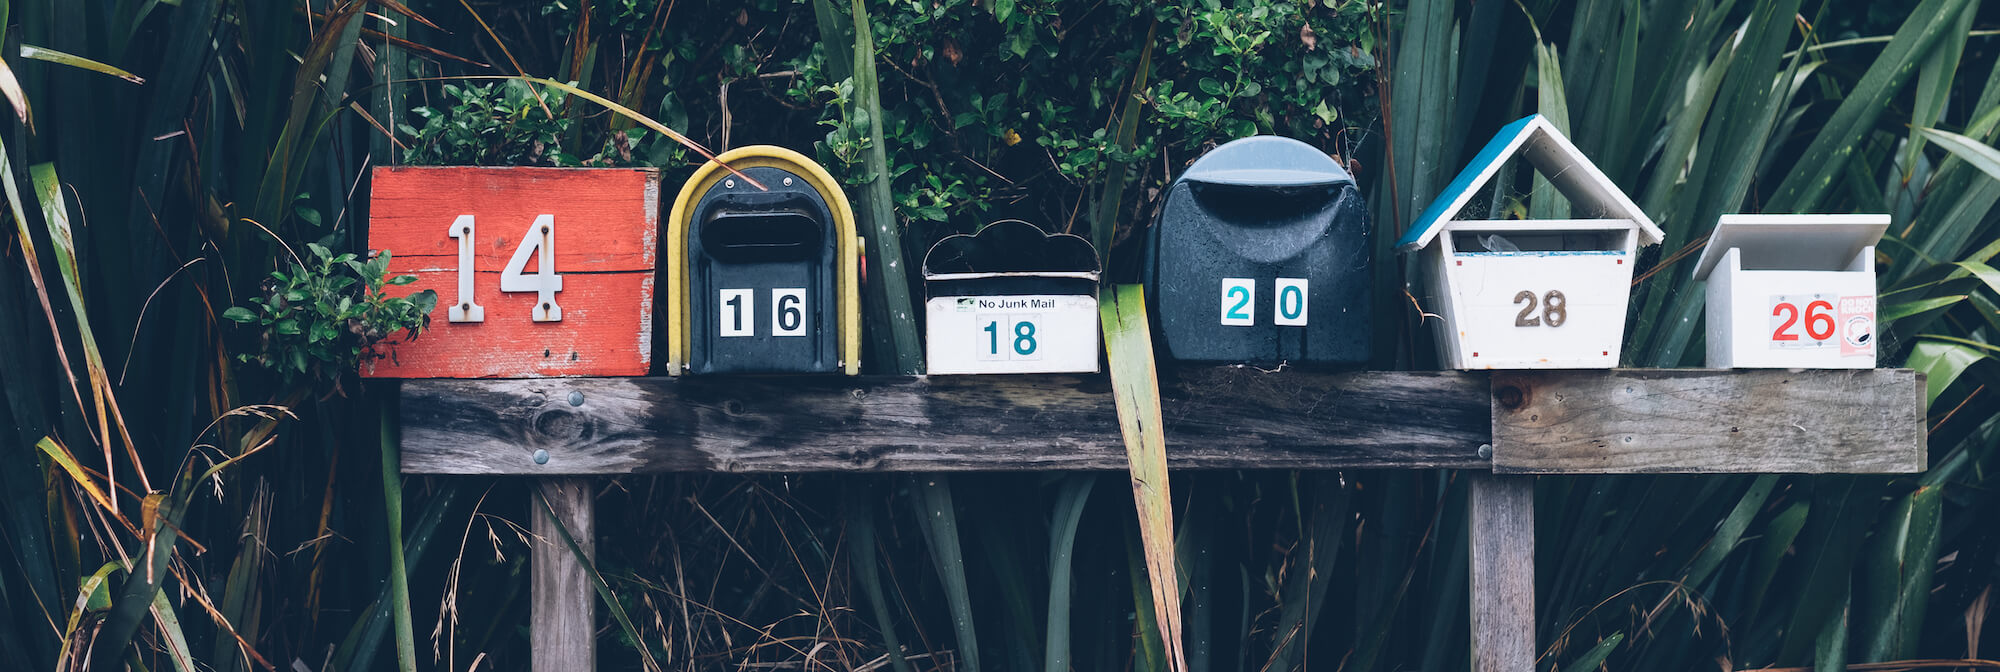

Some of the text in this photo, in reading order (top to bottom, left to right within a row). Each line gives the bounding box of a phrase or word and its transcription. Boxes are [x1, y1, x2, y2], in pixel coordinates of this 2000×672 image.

[448, 214, 563, 323] 14
[726, 294, 801, 331] 16
[979, 299, 1055, 309] No Junk Mail
[1226, 285, 1303, 320] 20
[1513, 289, 1567, 328] 28
[1841, 298, 1855, 306] DO
[984, 320, 1037, 356] 18
[1772, 300, 1836, 341] 26
